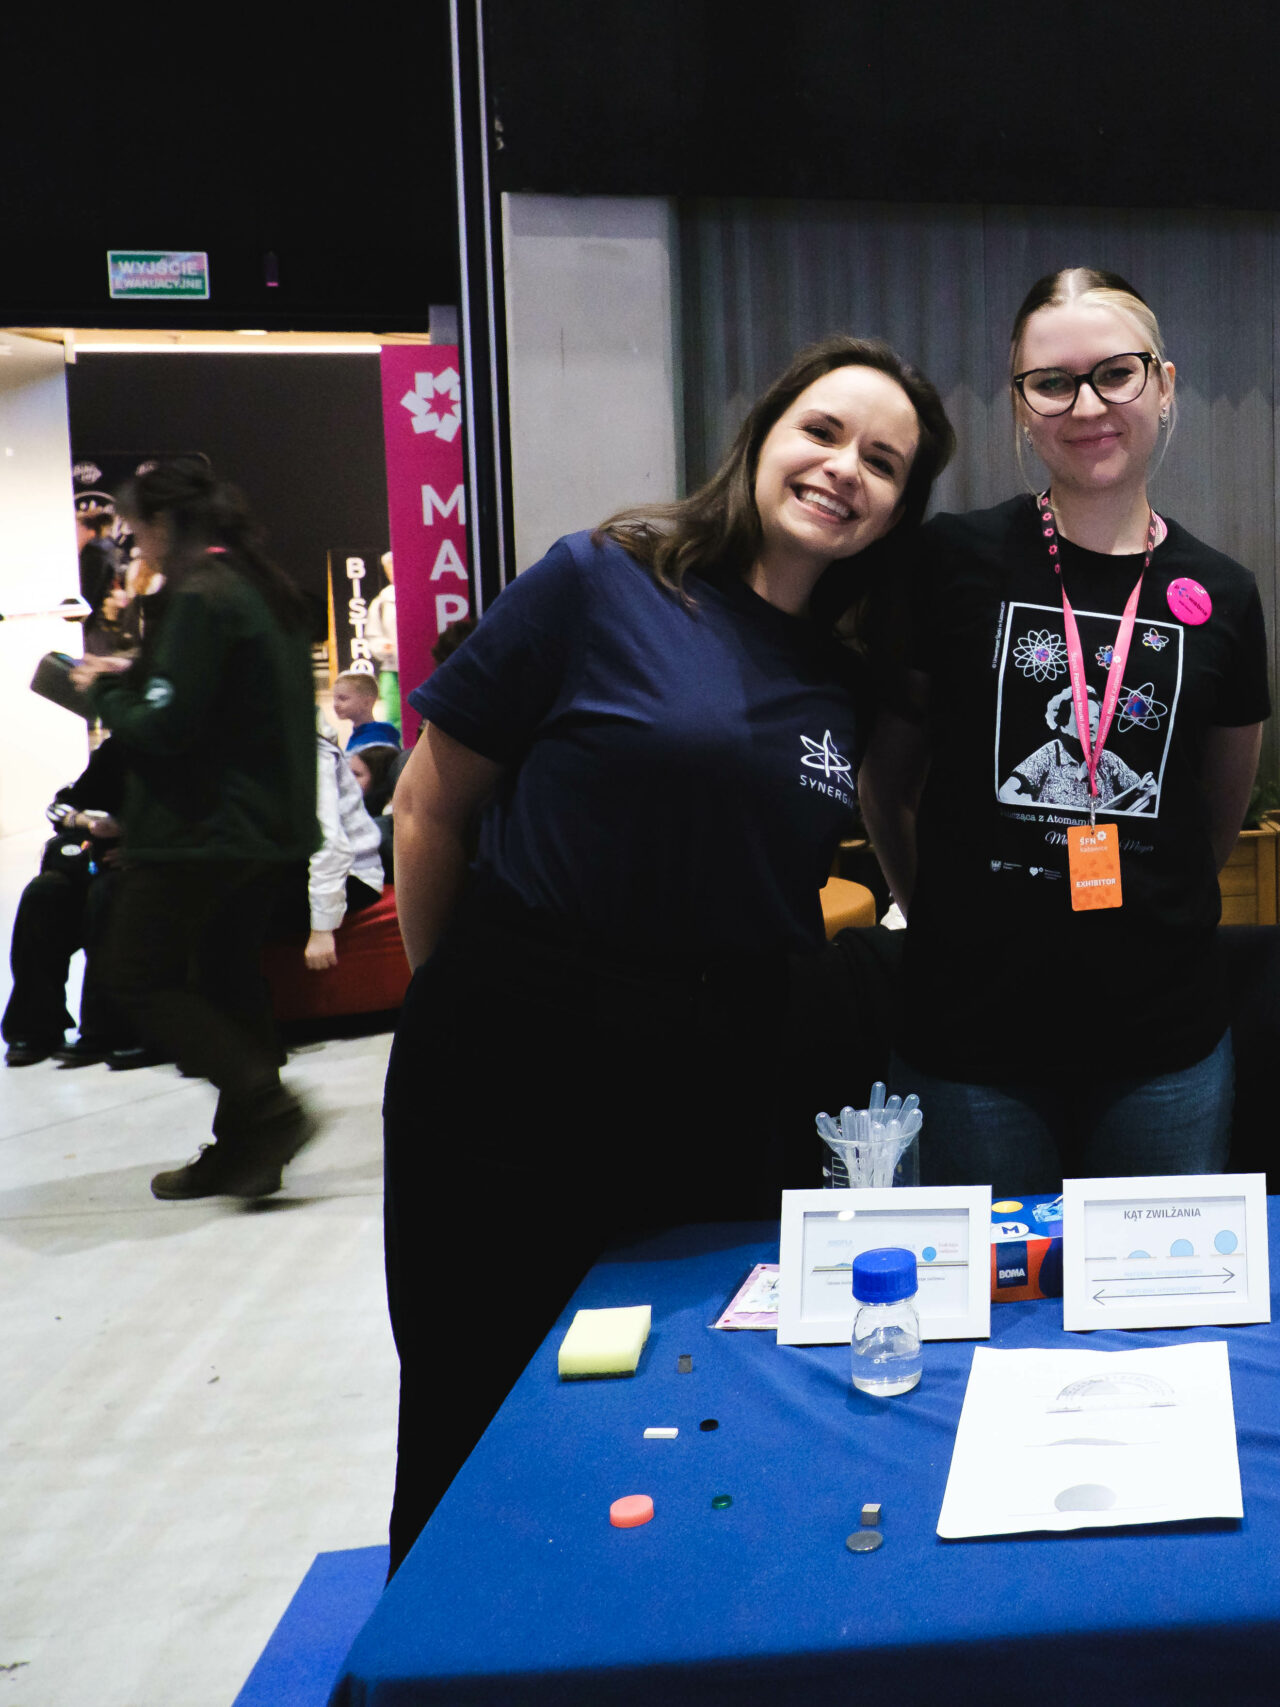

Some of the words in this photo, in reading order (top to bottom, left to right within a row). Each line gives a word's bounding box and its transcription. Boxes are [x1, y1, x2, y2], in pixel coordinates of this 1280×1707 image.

[1076, 878, 1116, 889] EXHIBITOR
[1123, 1210, 1144, 1222] KĄT
[1145, 1206, 1201, 1219] ZWILŻANIA
[1001, 1224, 1020, 1235] M
[998, 1267, 1026, 1280] BOMA
